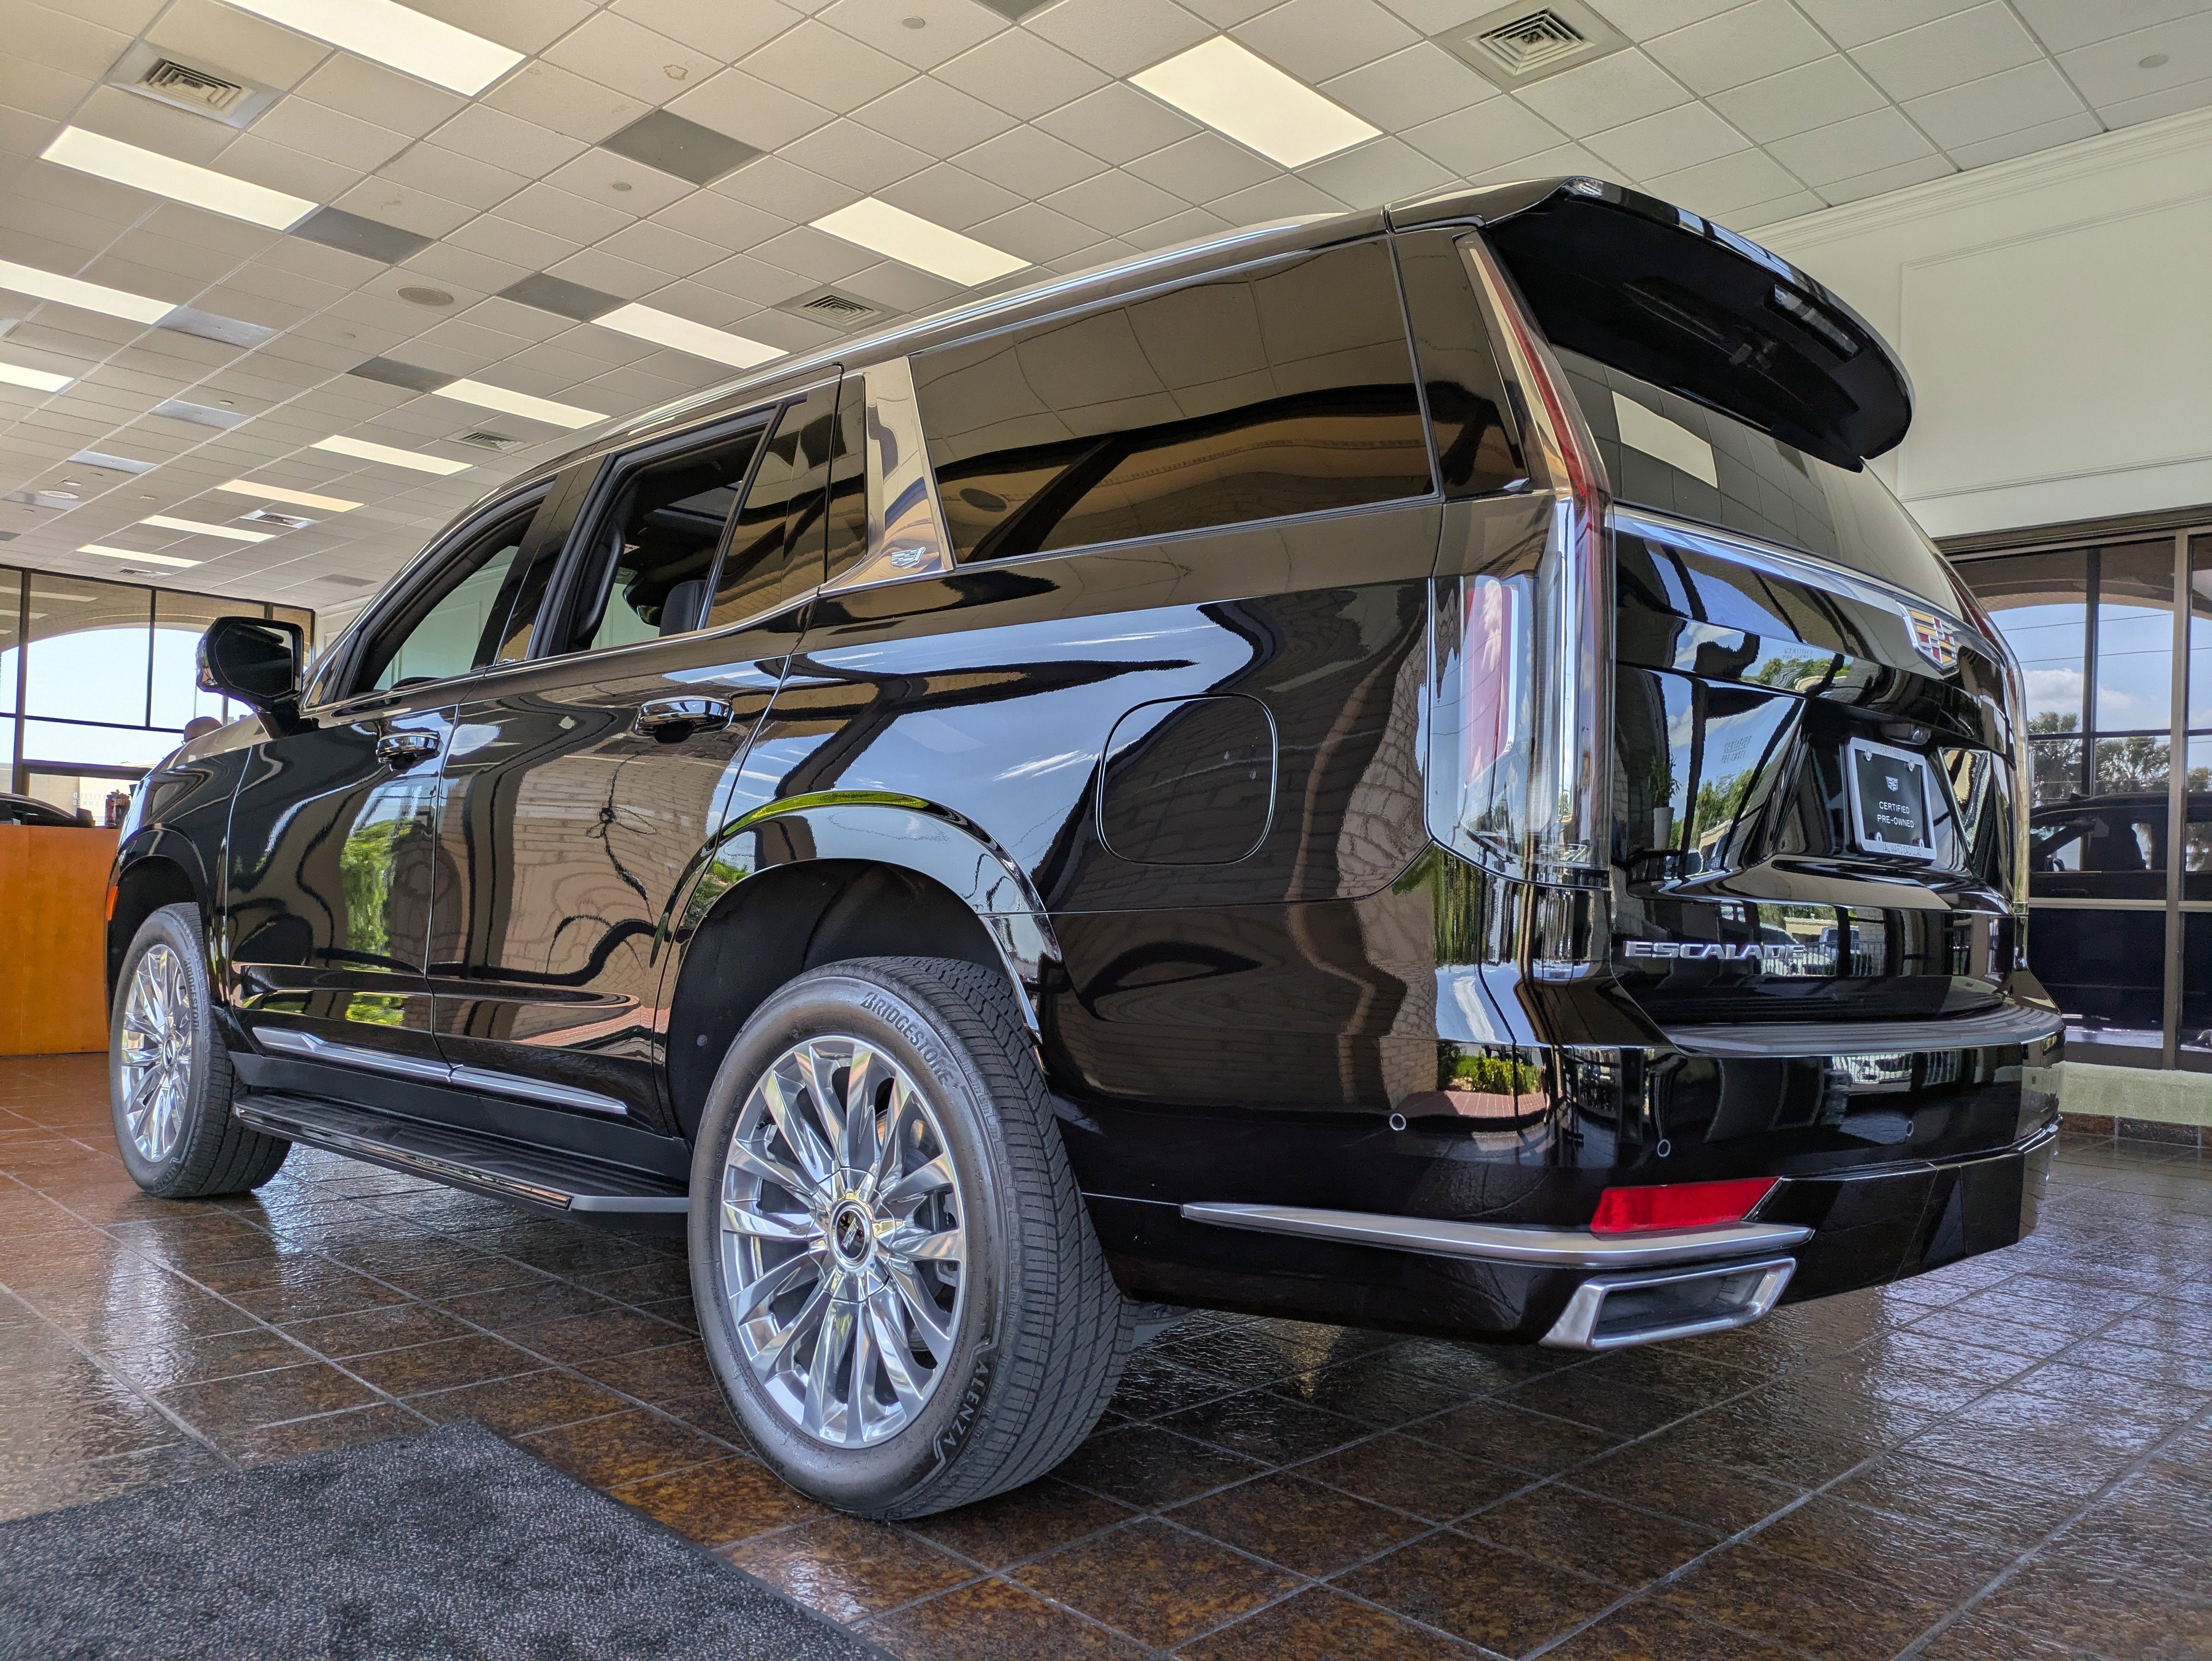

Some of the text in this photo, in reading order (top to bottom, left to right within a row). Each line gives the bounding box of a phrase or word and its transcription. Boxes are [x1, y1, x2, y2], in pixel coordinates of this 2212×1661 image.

[1879, 801, 1910, 814] CERTIFIED
[1877, 814, 1914, 828] PRE-OWNED
[1624, 941, 1805, 960] ESCALADE
[860, 991, 954, 1086] BRIDGESTONE
[944, 1359, 988, 1446] ALENZA
